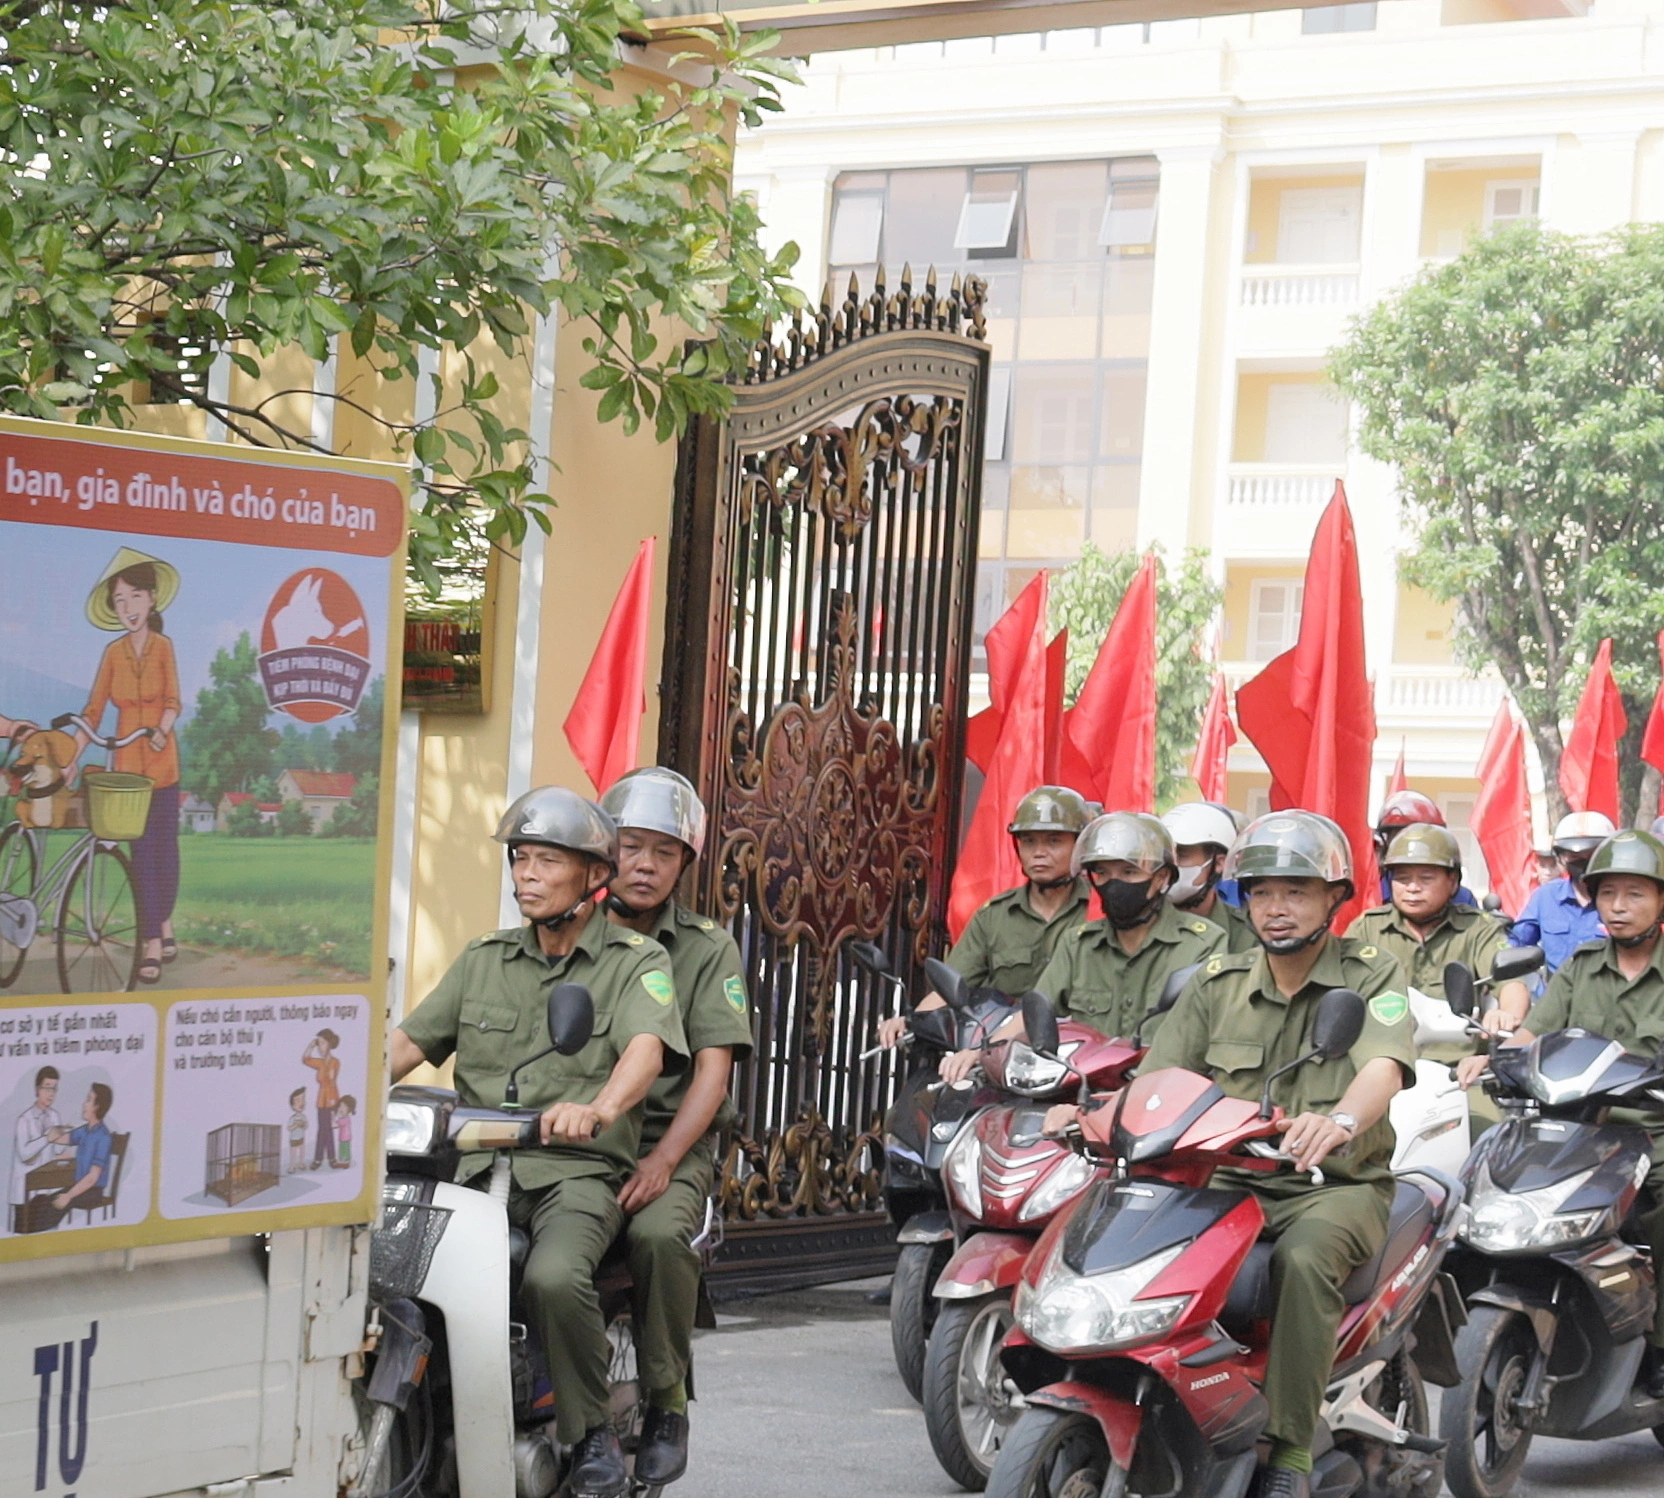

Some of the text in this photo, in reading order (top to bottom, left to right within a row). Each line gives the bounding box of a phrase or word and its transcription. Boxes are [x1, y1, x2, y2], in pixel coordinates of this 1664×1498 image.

[6, 463, 70, 506] bạn,
[77, 468, 118, 510] gia
[127, 472, 186, 511] đình
[193, 481, 223, 515] và
[230, 484, 275, 520] chó
[281, 488, 323, 526] của
[330, 492, 375, 537] bạn
[0, 1019, 15, 1034] cơ
[19, 1015, 33, 1033] sở
[36, 1017, 44, 1034] y
[48, 1013, 61, 1030] tế
[90, 1010, 117, 1029] nhất
[1190, 1371, 1230, 1391] HONDA
